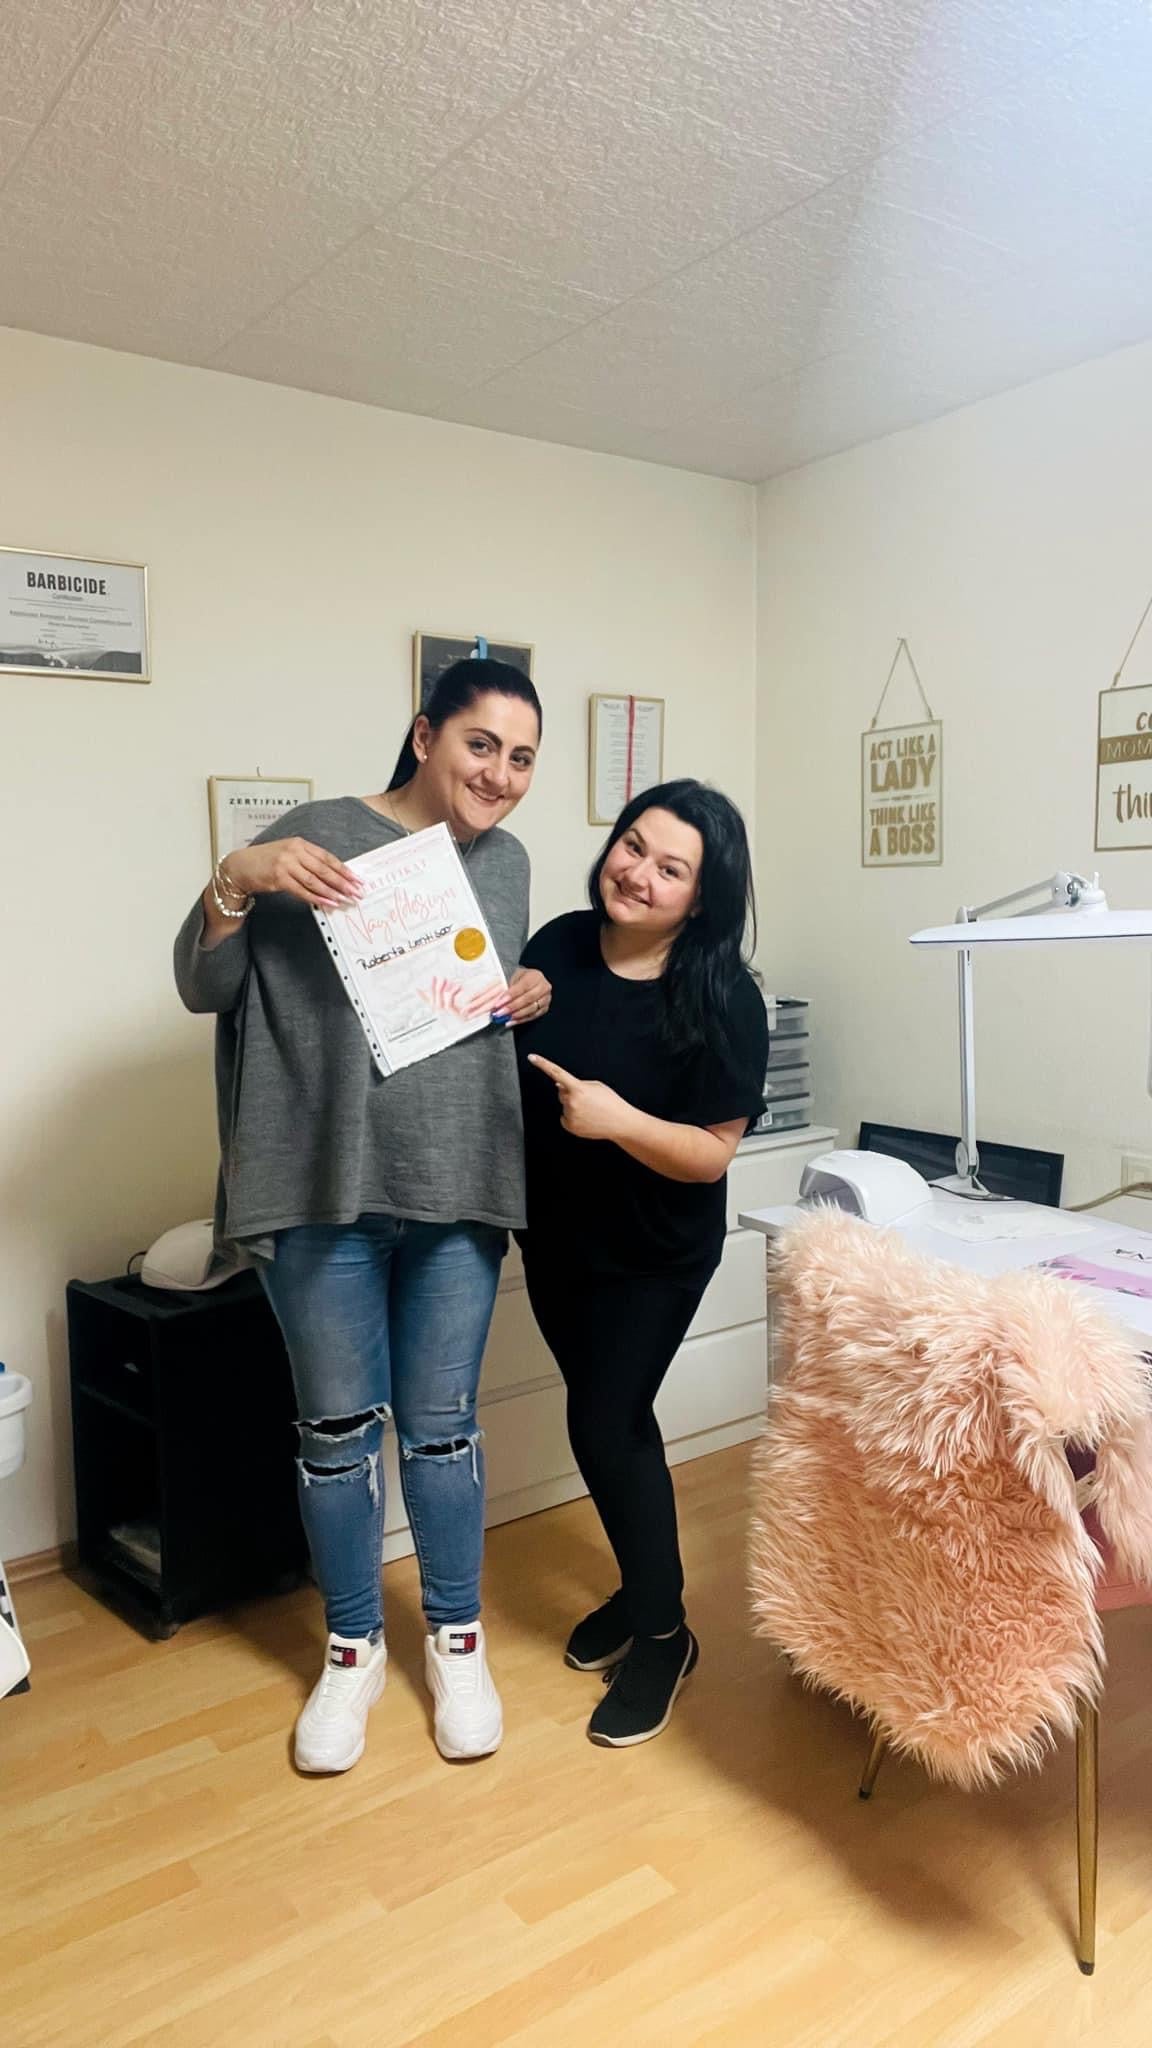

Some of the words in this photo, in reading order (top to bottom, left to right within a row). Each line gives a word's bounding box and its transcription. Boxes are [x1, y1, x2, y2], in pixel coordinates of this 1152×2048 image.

[27, 571, 107, 595] BARBICIDE
[870, 740, 893, 761] ACT
[897, 735, 924, 758] LIKE
[928, 733, 936, 754] A
[871, 754, 936, 793] LADY
[229, 798, 298, 806] ZERTIFIKAT
[869, 806, 904, 826] THINK
[908, 802, 936, 823] LIKE
[1112, 783, 1152, 823] thi
[869, 827, 881, 856] A
[887, 822, 936, 856] BOSS
[356, 944, 406, 971] Roberta
